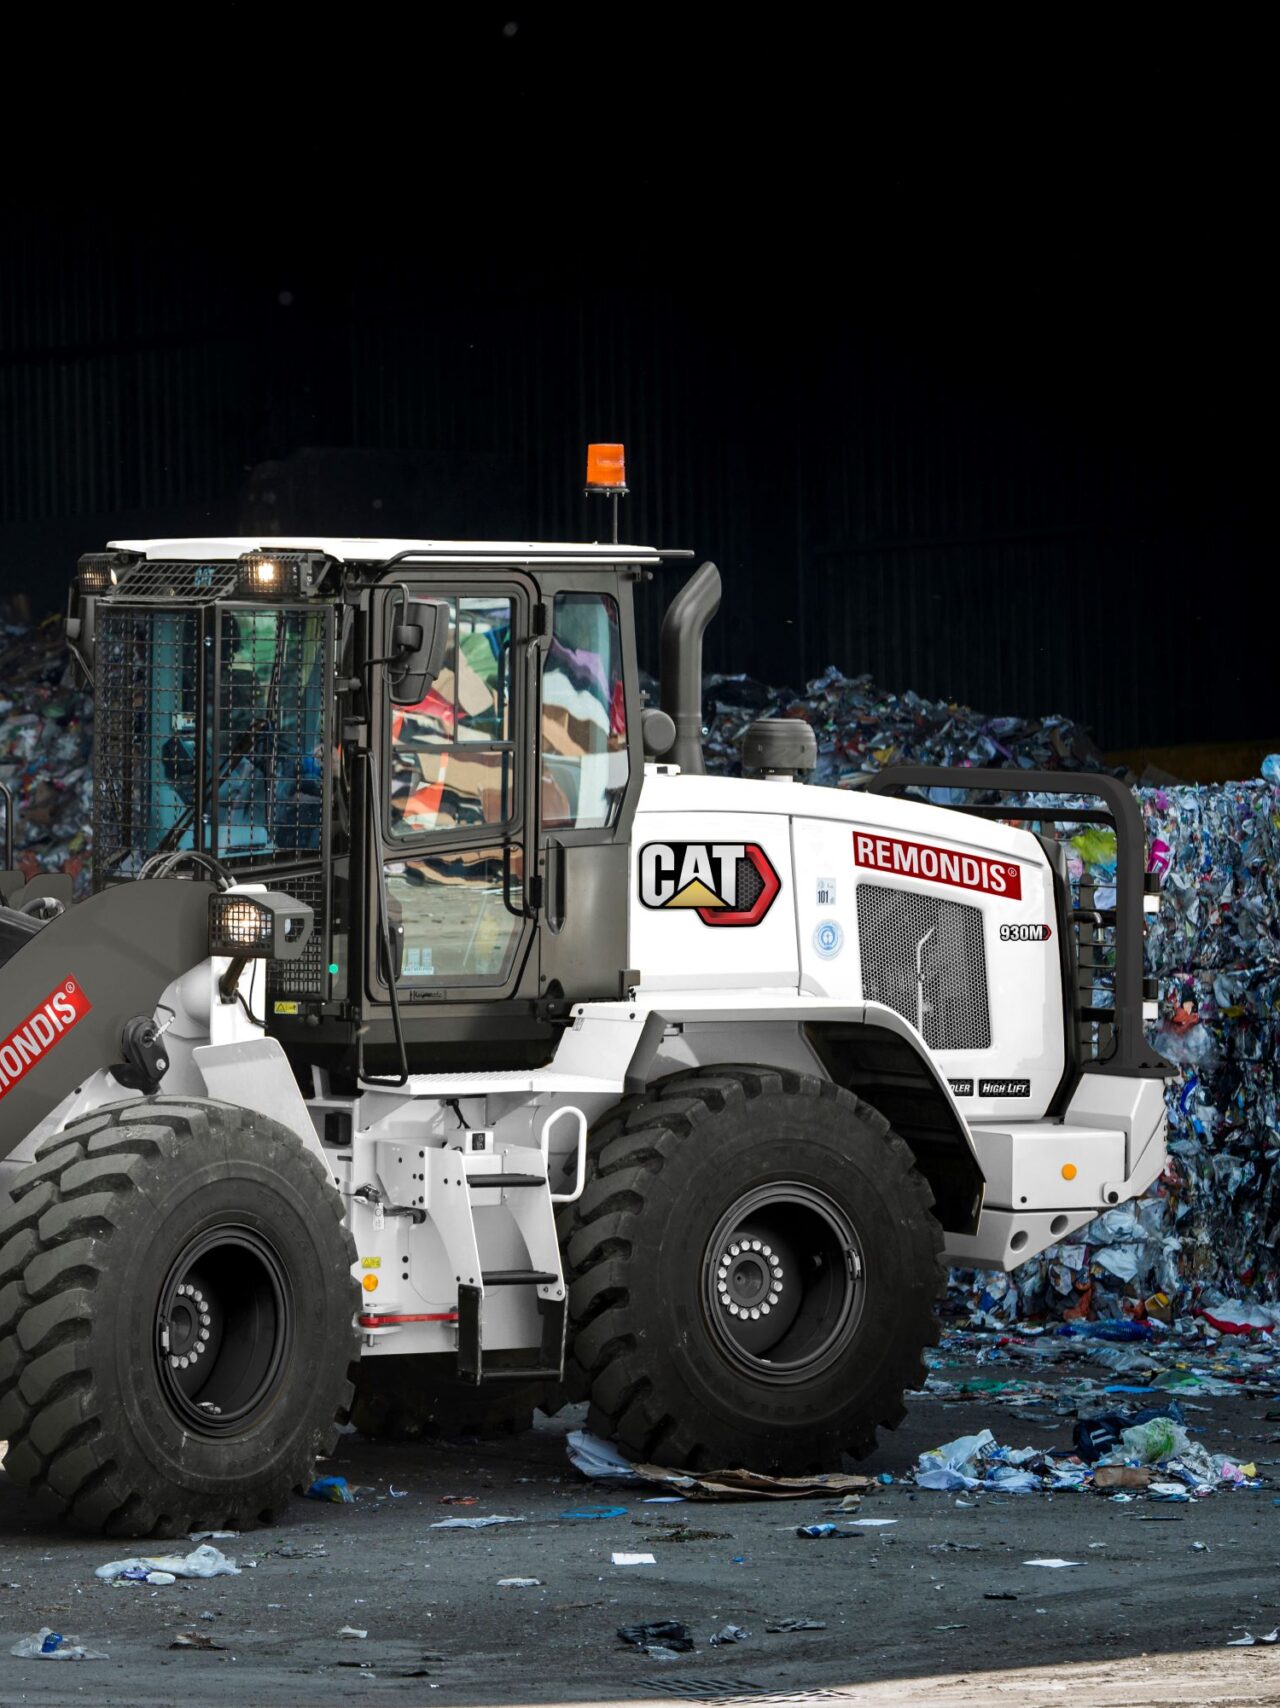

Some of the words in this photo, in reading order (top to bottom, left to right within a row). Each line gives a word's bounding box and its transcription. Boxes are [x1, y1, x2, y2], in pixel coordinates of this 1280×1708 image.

[641, 843, 745, 907] CAT
[817, 889, 829, 904] 101
[1000, 924, 1044, 941] 930M
[982, 1083, 1006, 1093] HIGH
[1007, 1083, 1028, 1093] LIFT
